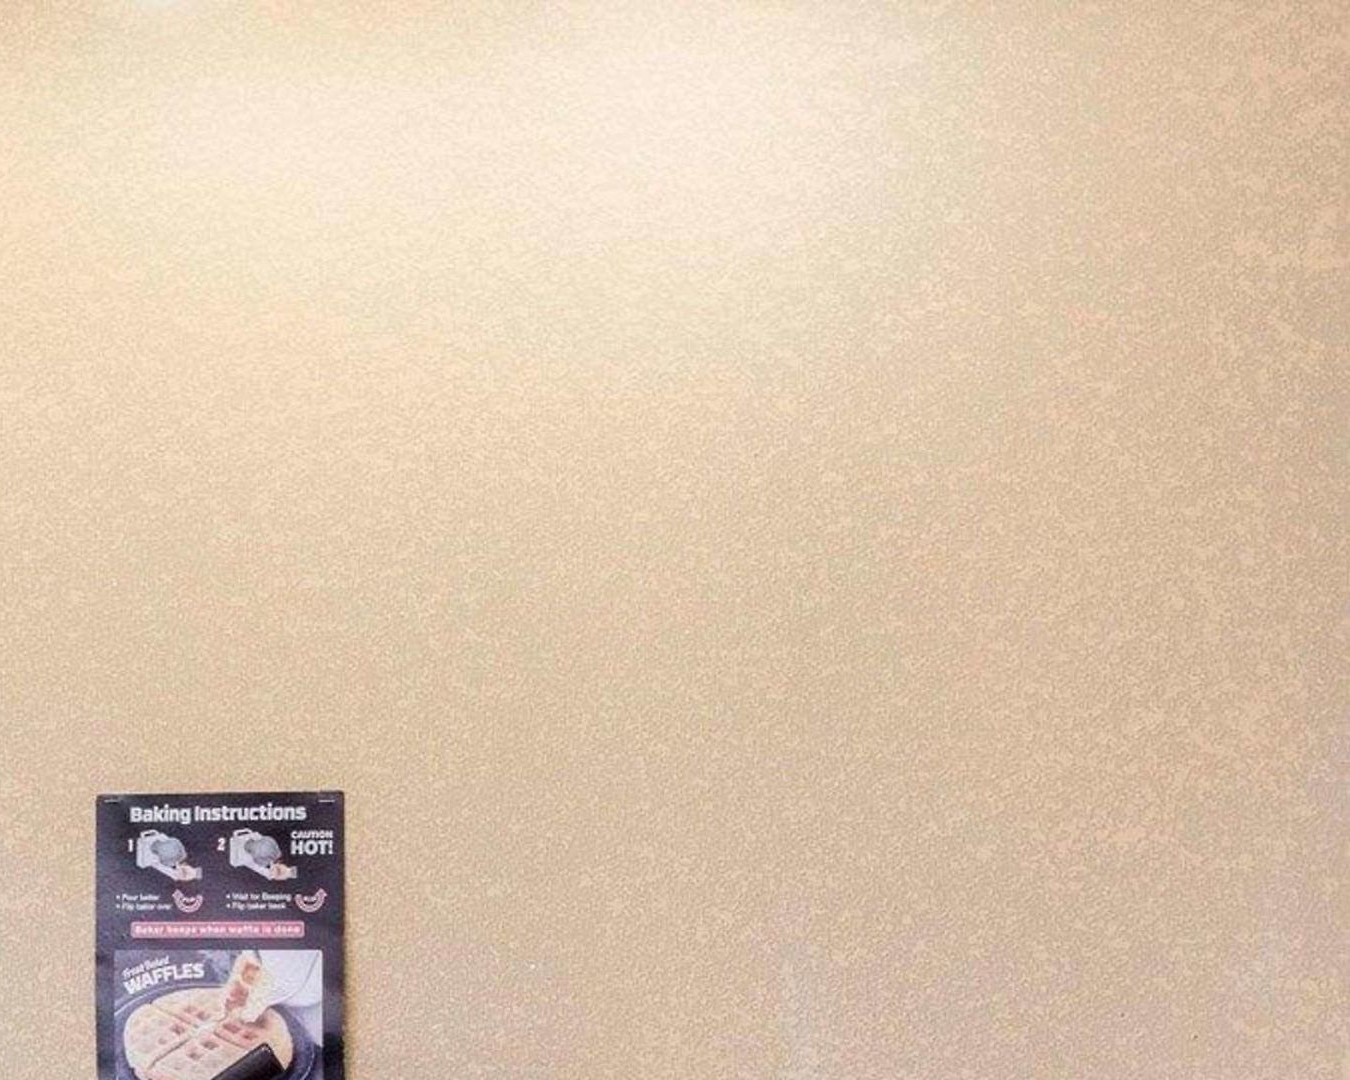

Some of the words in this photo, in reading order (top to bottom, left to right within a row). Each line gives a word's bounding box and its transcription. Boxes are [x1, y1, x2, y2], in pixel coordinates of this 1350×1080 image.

[130, 804, 191, 824] Baking
[195, 802, 307, 822] Instructions
[291, 830, 334, 839] CAUTION
[127, 839, 134, 852] 1
[217, 838, 225, 852] 2
[290, 840, 334, 855] HOT!
[123, 963, 205, 994] WAFFLES
